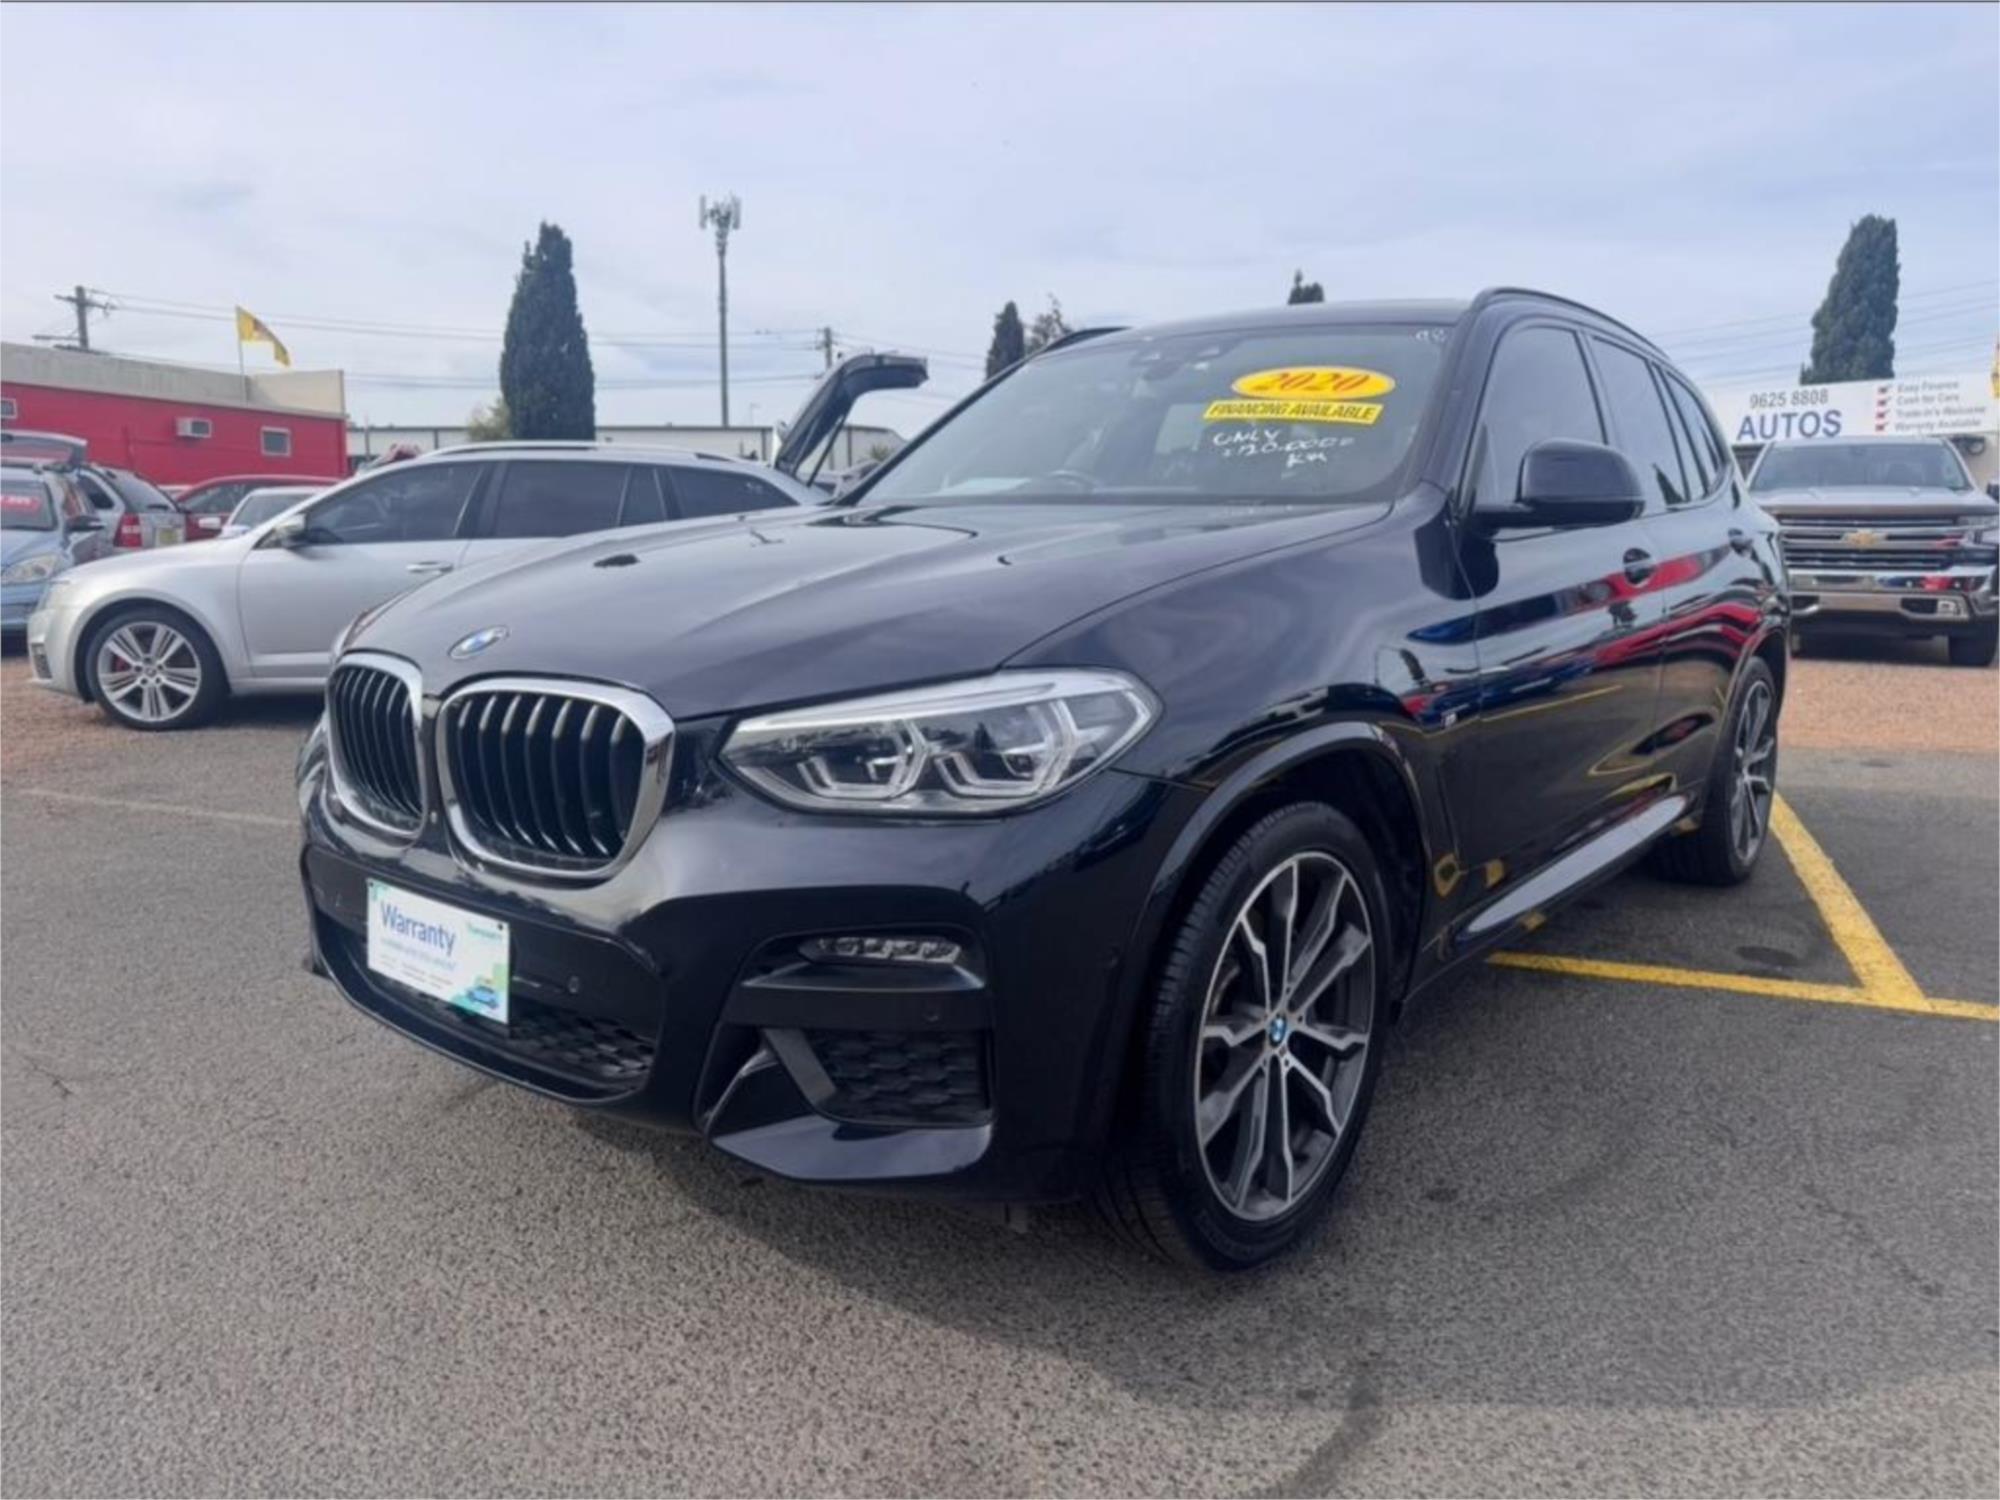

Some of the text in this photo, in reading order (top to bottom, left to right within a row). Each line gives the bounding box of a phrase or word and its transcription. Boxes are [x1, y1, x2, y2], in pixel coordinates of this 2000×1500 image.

[1253, 372, 1371, 392] 2020
[1749, 388, 1829, 409] 9625 8808
[1210, 402, 1376, 420] FINANCING AVAILABLE
[1736, 409, 1843, 441] AUTOS
[380, 901, 456, 957] Warranty
